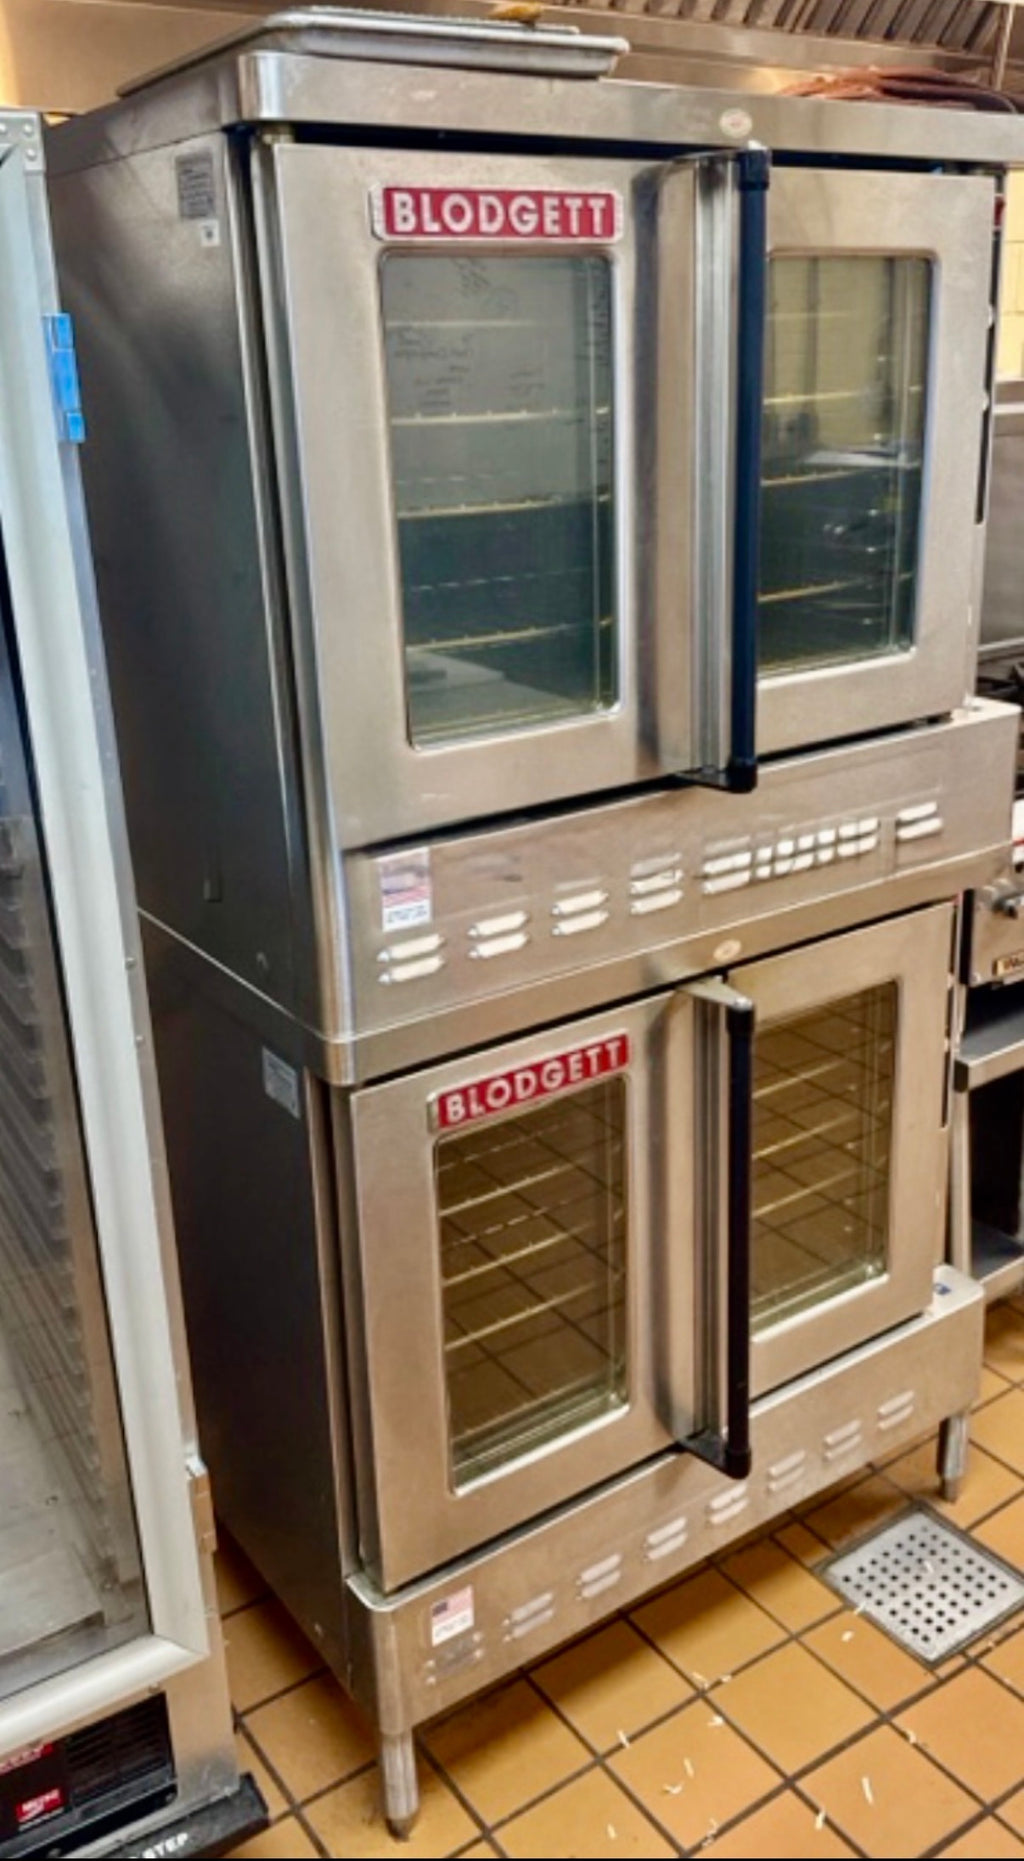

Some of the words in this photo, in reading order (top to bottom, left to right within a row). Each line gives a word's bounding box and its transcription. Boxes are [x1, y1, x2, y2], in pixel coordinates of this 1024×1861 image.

[393, 192, 607, 235] BLODGETT
[445, 1040, 622, 1123] BLODGETT
[142, 1832, 188, 1859] STEP
